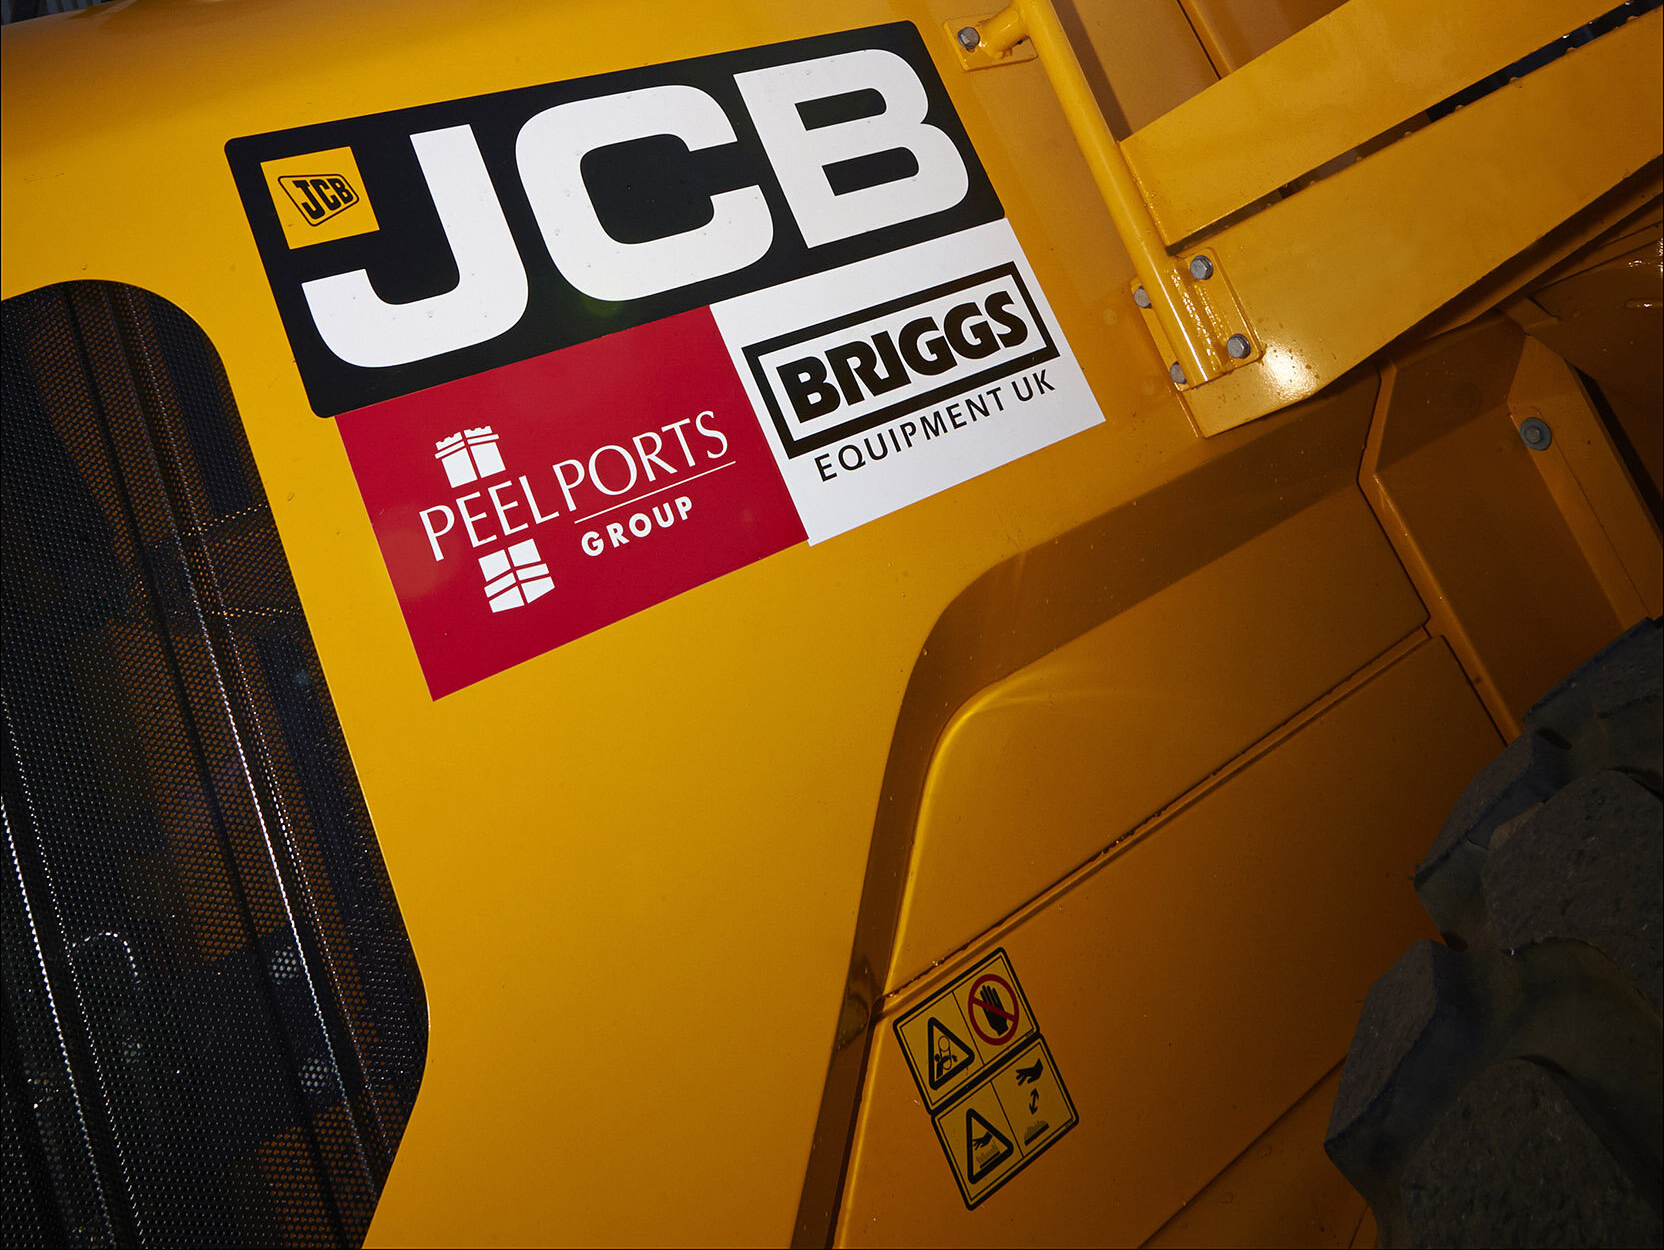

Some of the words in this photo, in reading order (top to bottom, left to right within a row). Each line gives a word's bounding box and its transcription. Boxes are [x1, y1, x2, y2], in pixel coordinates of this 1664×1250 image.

[292, 178, 354, 219] JCB
[300, 48, 970, 368] JCB
[776, 290, 1028, 423] BRIGGS
[419, 475, 560, 562] PEEL
[552, 410, 728, 512] PORTS
[814, 387, 1004, 482] EQUIPMENT
[1011, 369, 1056, 402] UK
[581, 496, 693, 557] GROUP
